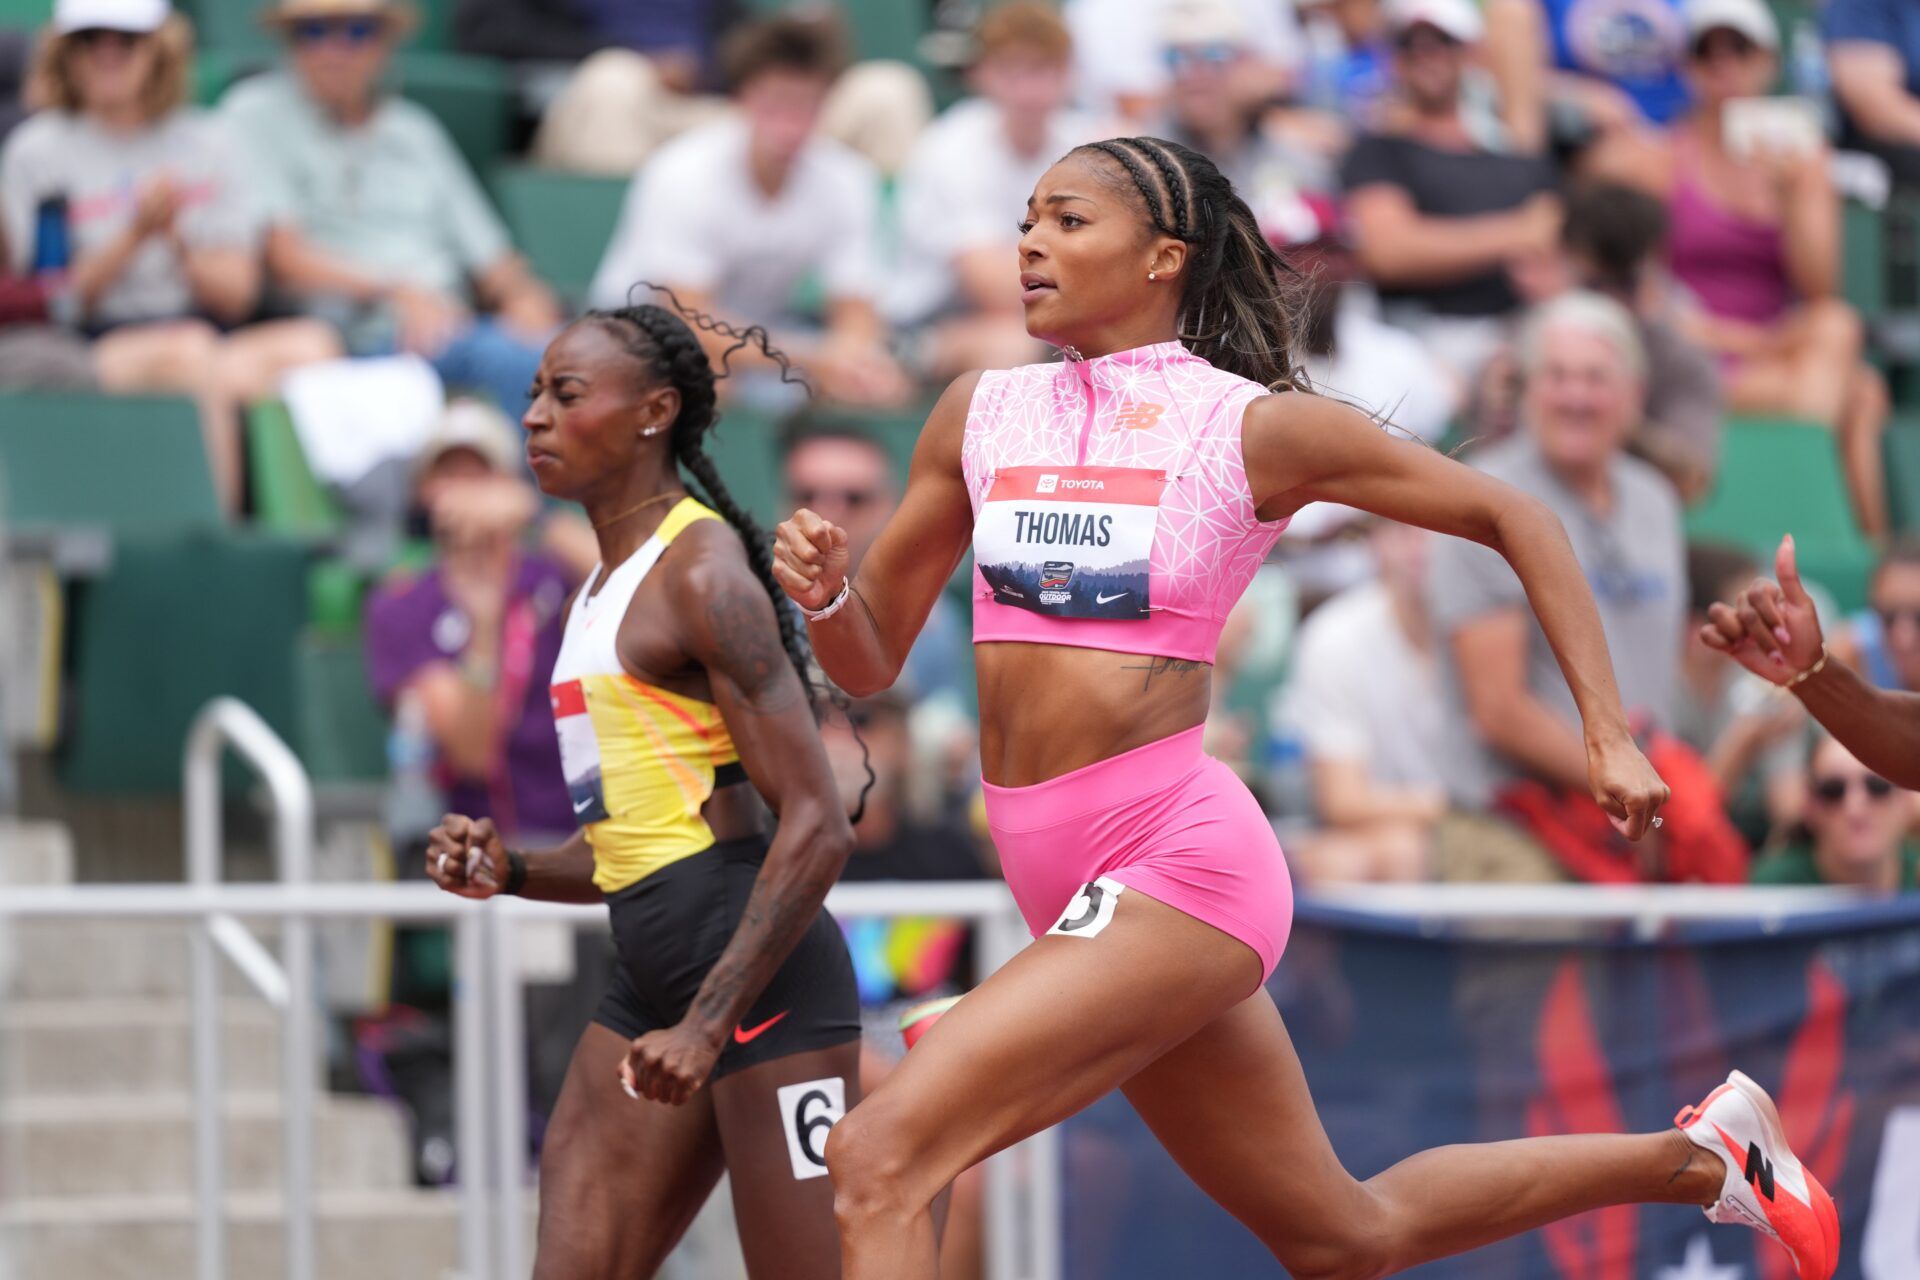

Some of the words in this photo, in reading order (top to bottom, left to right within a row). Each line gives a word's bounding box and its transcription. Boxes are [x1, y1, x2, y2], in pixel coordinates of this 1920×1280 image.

[1061, 480, 1104, 490] TOYOTA
[1015, 511, 1112, 547] THOMAS
[1039, 593, 1072, 601] OUTDOOR
[796, 1089, 834, 1167] 6
[1745, 1141, 1775, 1203] N
